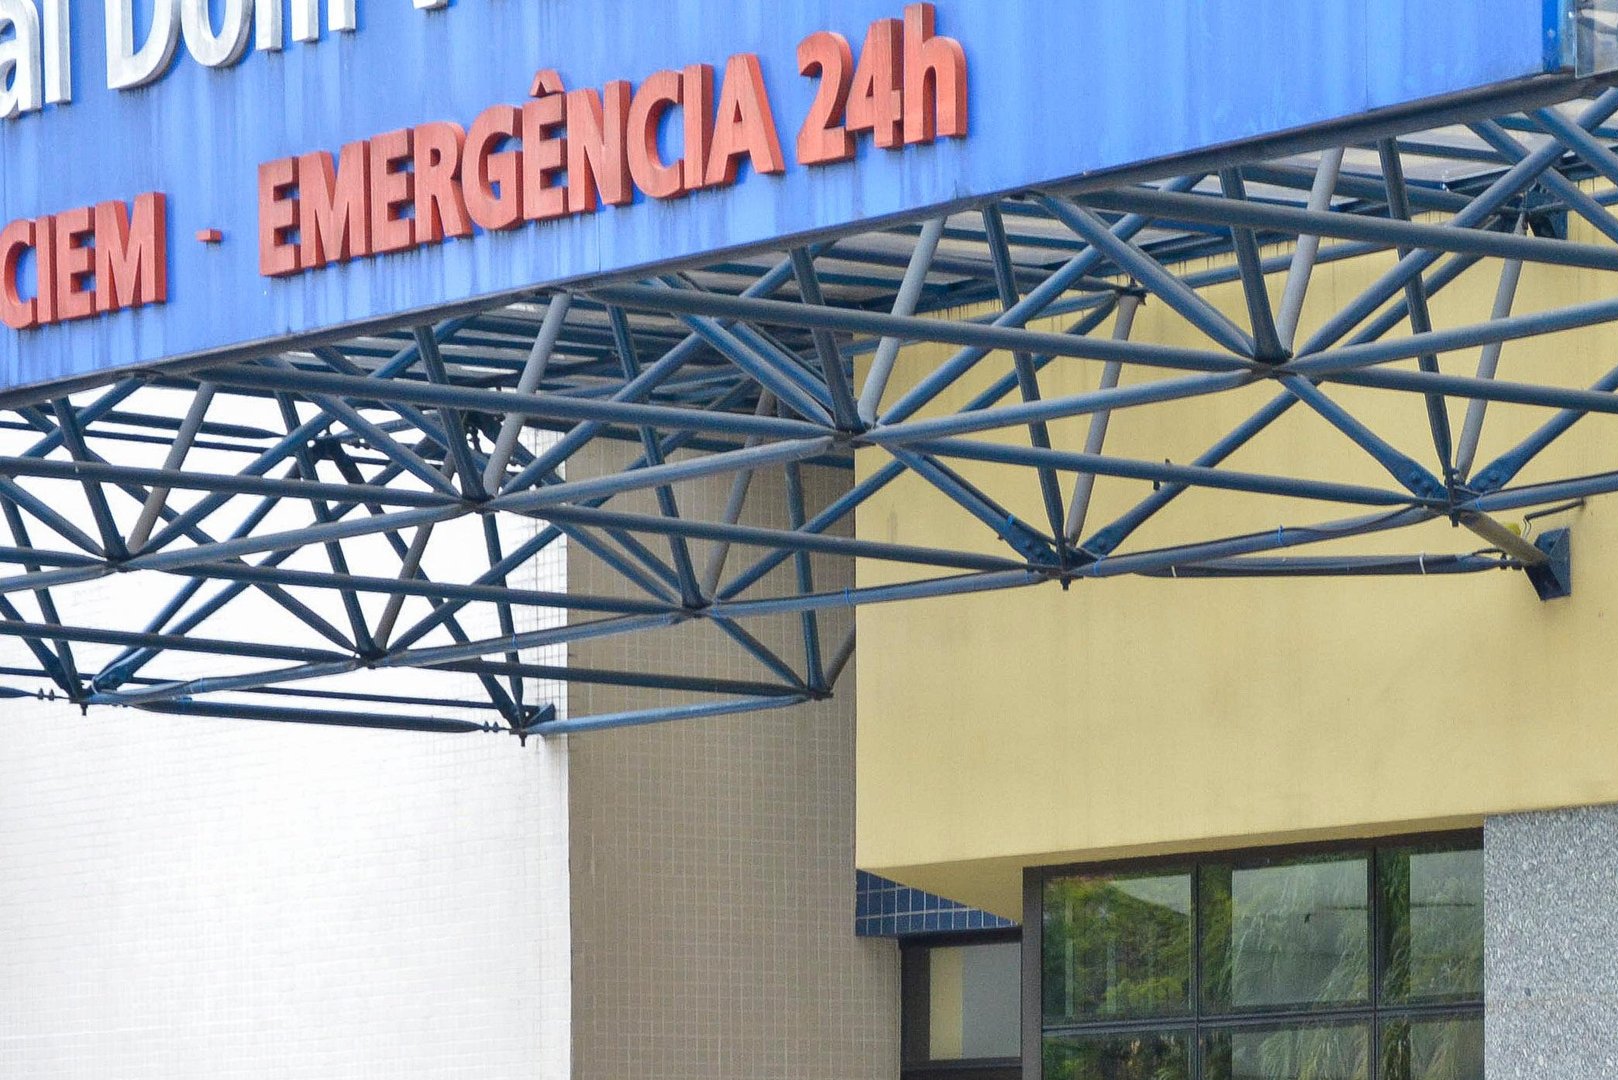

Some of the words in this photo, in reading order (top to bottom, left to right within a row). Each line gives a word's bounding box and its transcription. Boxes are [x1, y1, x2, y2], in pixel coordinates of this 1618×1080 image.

[0, 191, 167, 330] CIEM
[258, 54, 785, 276] EMERGÊNCIA
[797, 3, 968, 166] 24h
